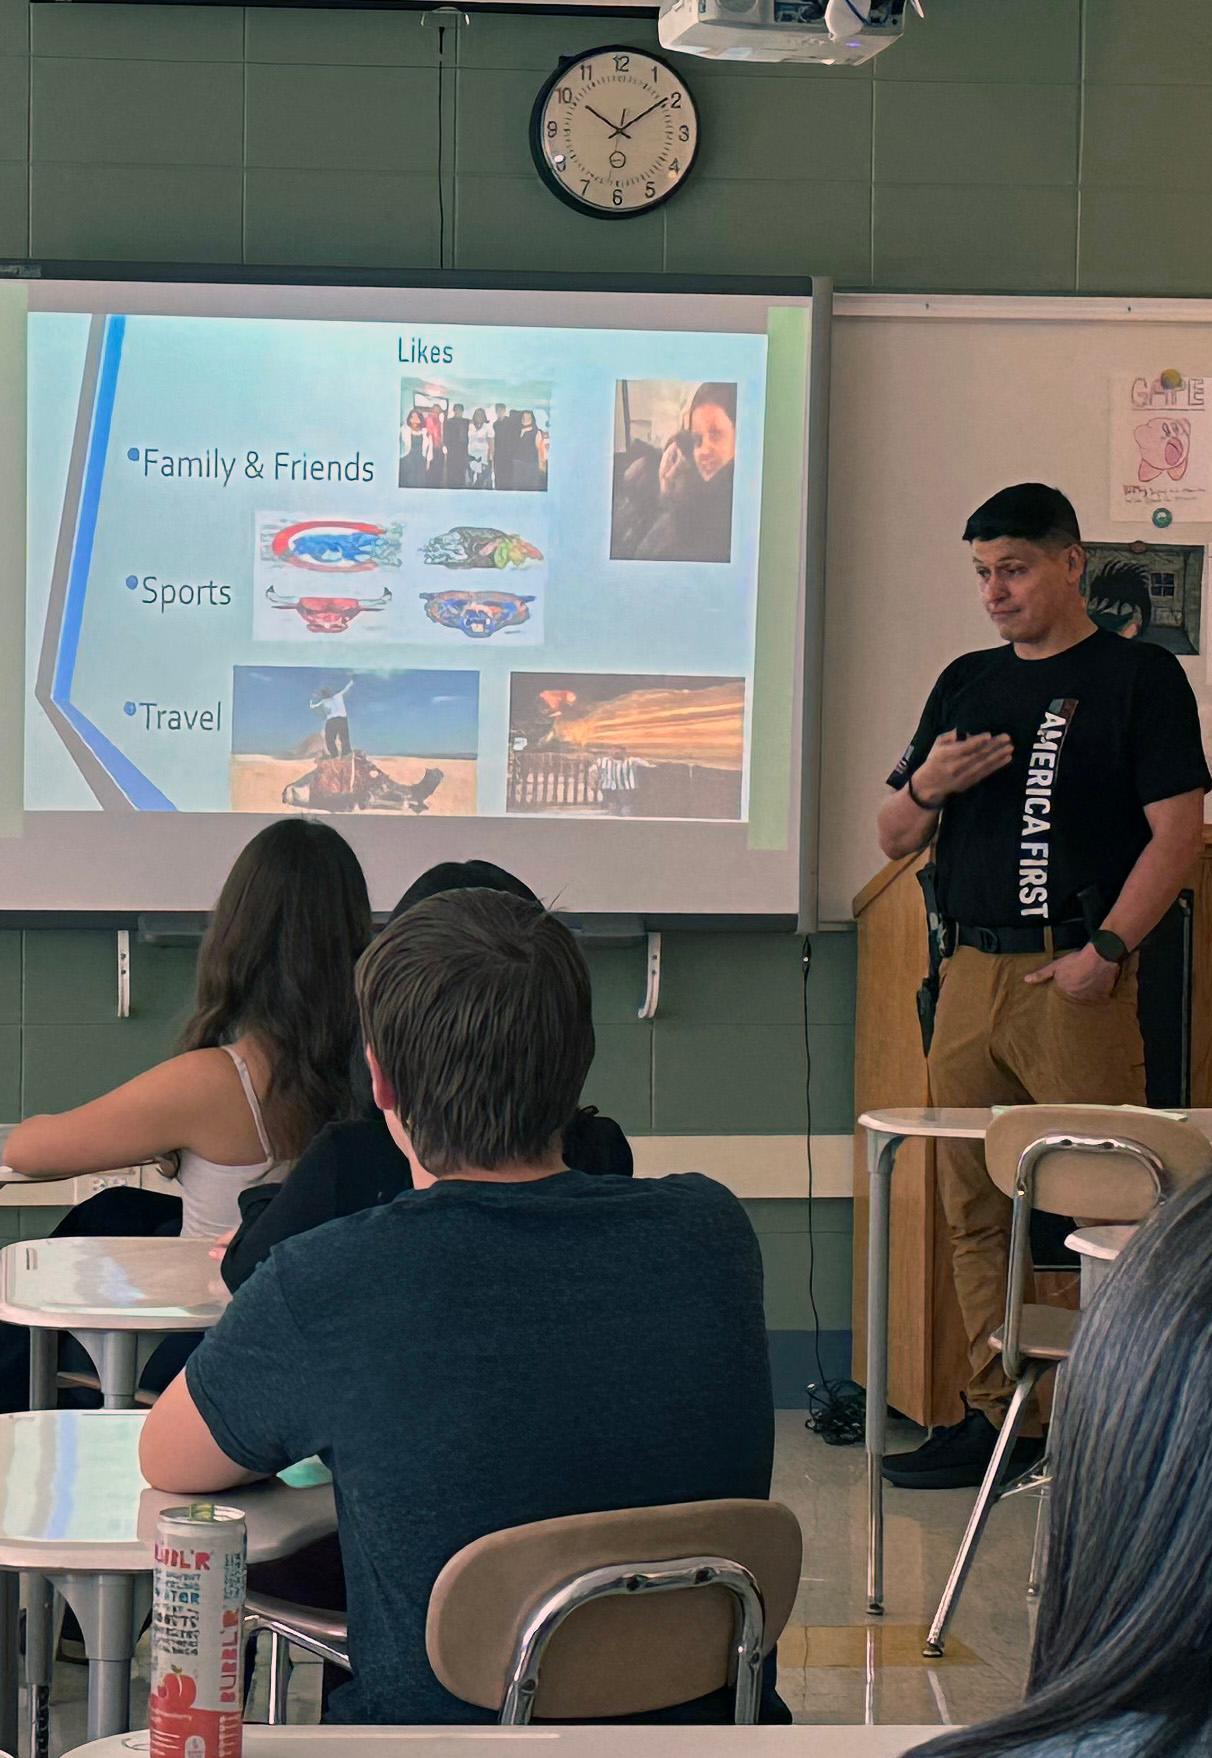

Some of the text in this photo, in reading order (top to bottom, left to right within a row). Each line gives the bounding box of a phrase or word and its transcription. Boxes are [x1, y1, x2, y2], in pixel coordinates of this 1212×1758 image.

[613, 56, 630, 72] 12
[580, 65, 592, 81] 11
[651, 66, 658, 83] 1
[557, 87, 572, 104] 10
[670, 92, 682, 109] 2
[547, 121, 558, 138] 9
[679, 125, 690, 142] 3
[668, 158, 680, 174] 4
[580, 179, 591, 196] 7
[644, 181, 656, 198] 5
[612, 189, 623, 205] 6
[397, 336, 455, 365] Likes
[143, 447, 375, 487] Family & Friends
[141, 575, 233, 614] Sports
[139, 701, 221, 732] Travel
[1017, 712, 1065, 919] AMERICA FIRST
